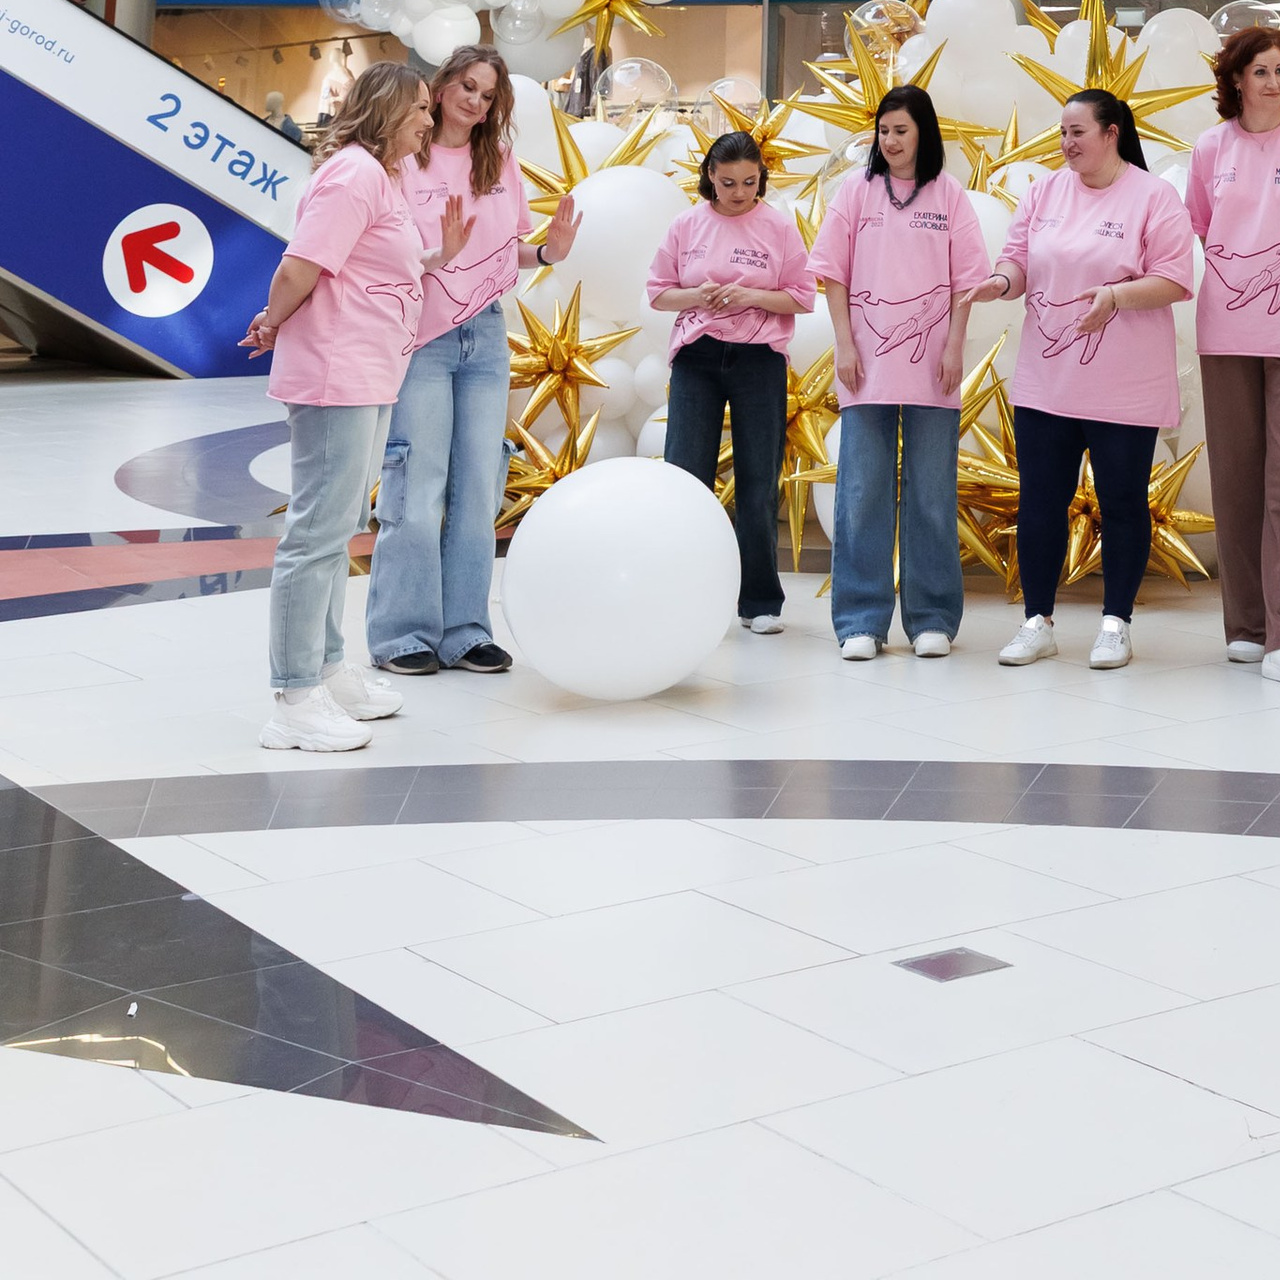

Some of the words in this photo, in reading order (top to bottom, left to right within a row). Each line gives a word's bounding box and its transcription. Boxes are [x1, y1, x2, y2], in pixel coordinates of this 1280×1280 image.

[0, 9, 75, 64] i-gorod.ru
[146, 92, 182, 133] 2
[182, 121, 290, 202] этаж
[913, 211, 948, 222] ЕКАТЕРИНА
[733, 247, 769, 260] АНАСТАСИЯ
[729, 256, 768, 269] ШЕСТАКОВА
